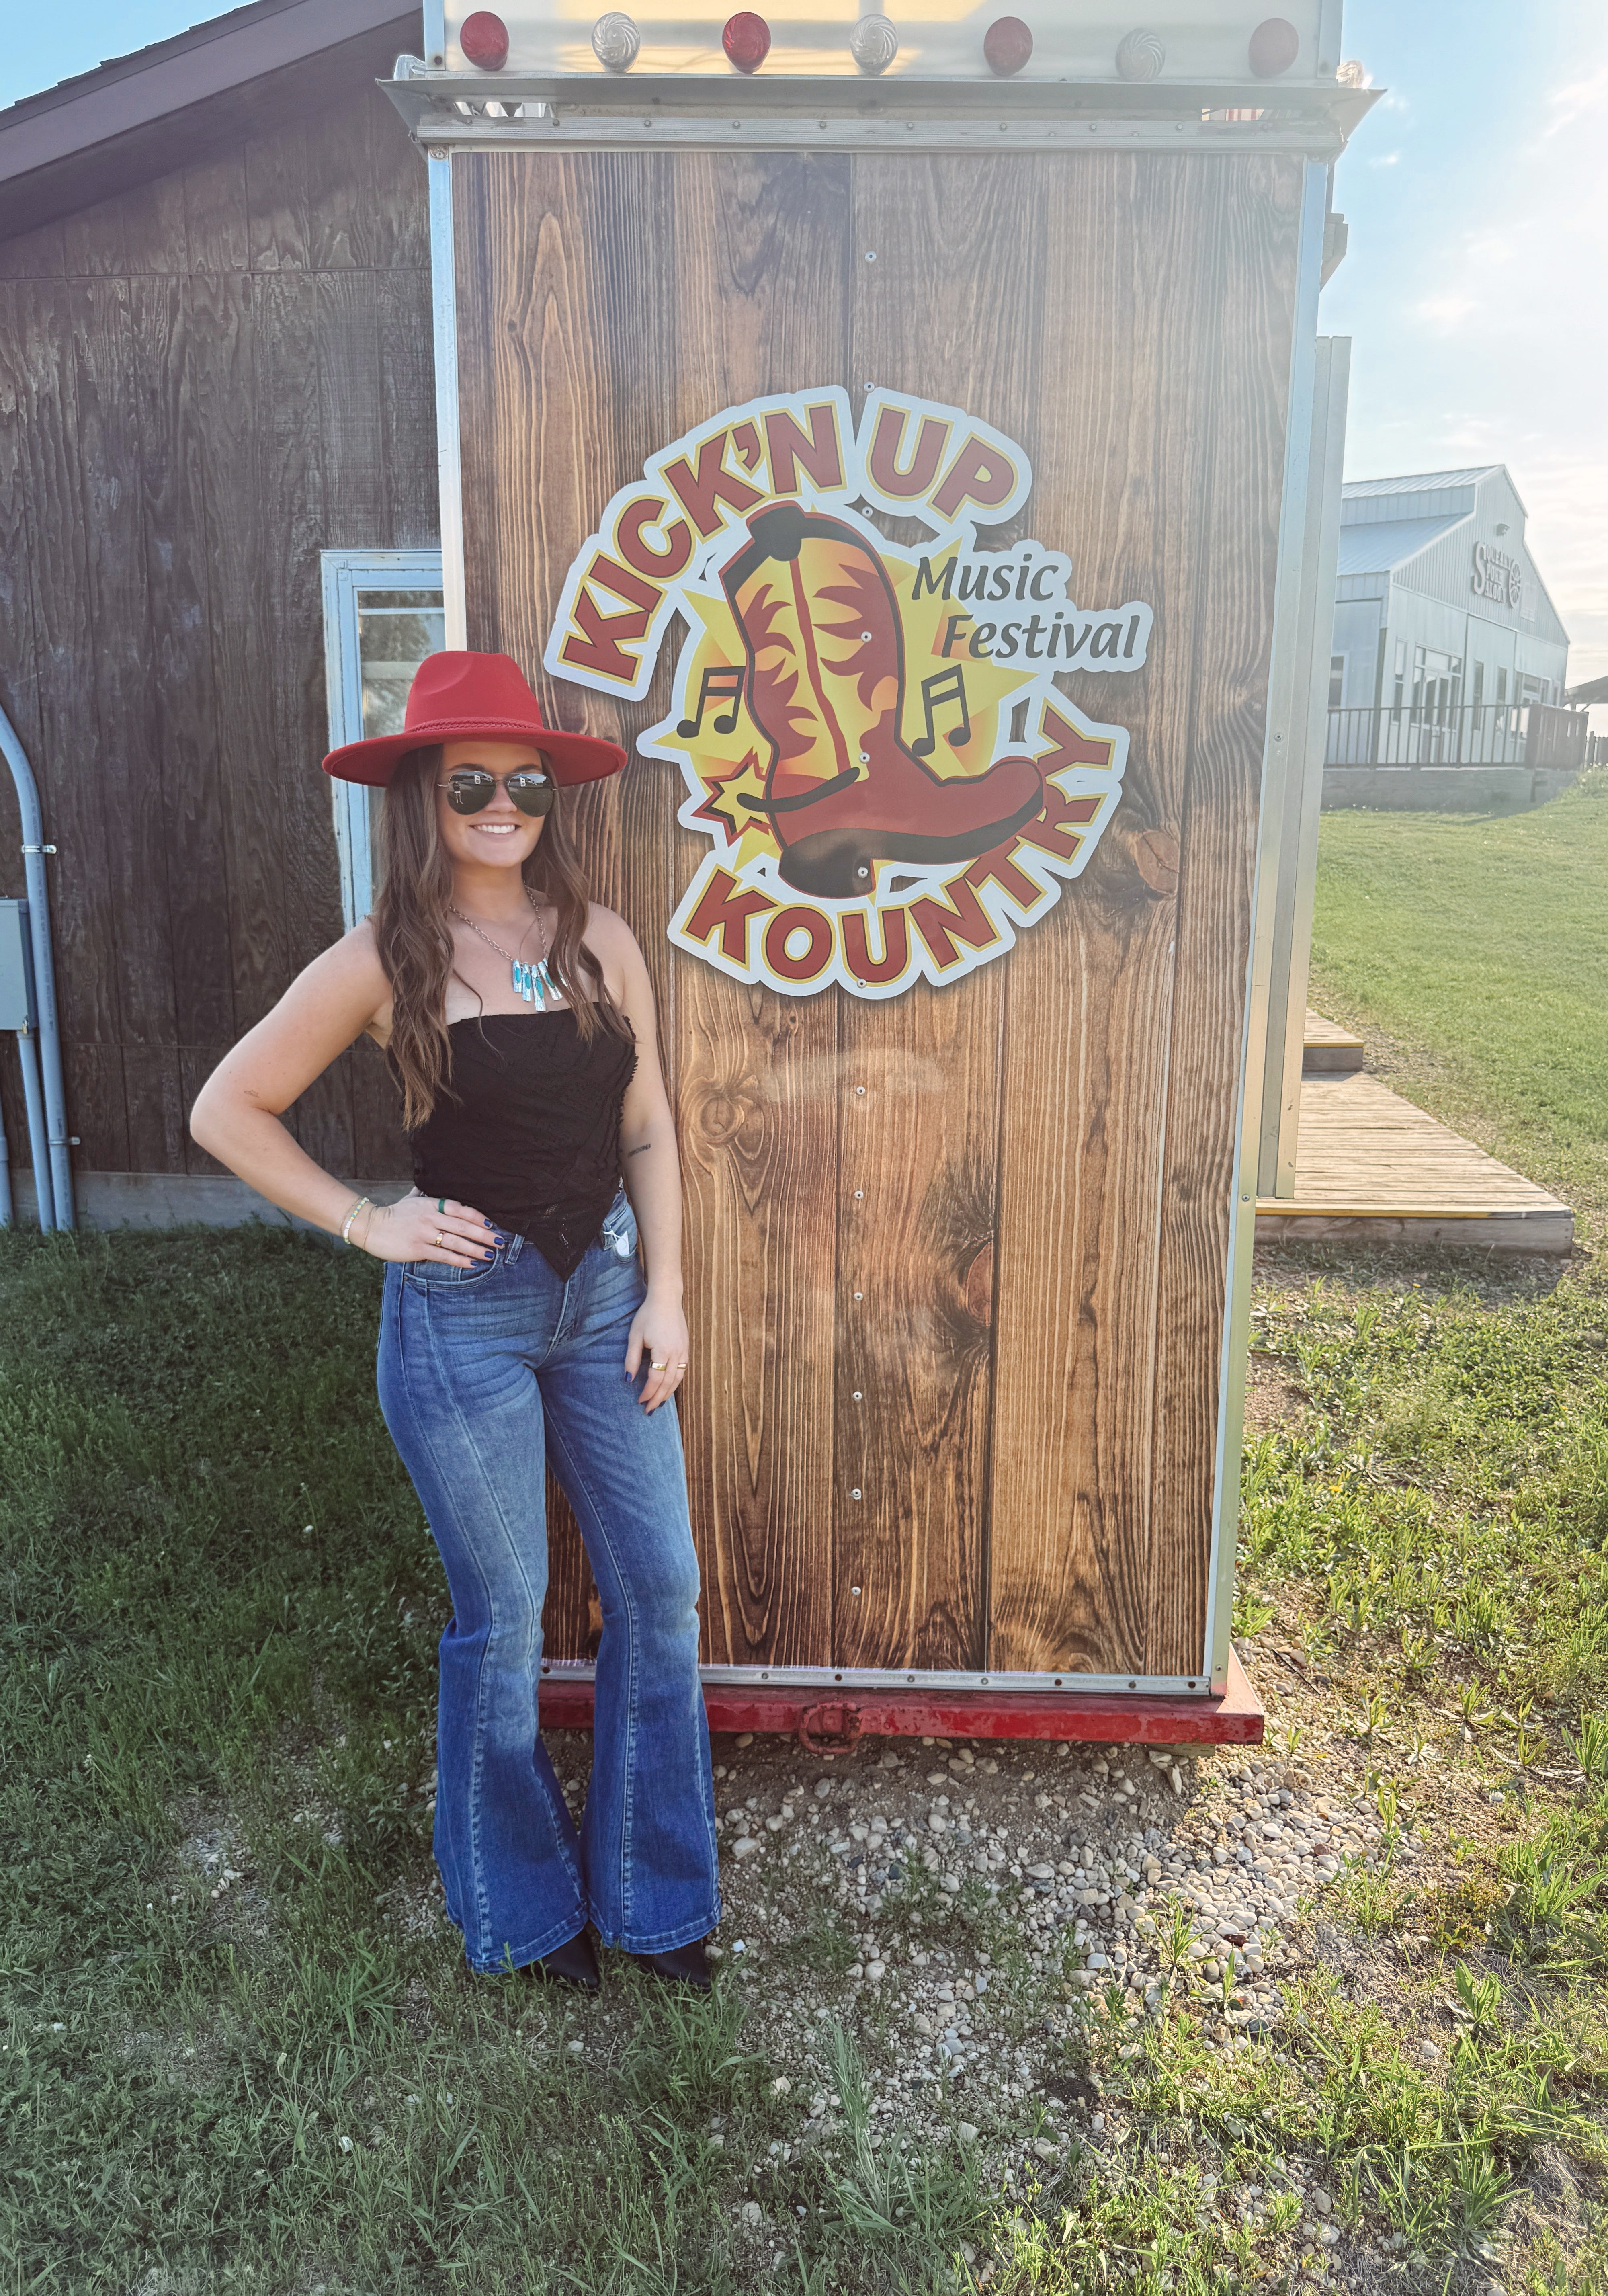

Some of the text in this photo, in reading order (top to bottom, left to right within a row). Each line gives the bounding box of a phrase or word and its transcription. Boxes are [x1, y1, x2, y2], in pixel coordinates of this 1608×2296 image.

[556, 400, 1019, 688] KICK'N UP
[912, 550, 1059, 601] Music
[942, 613, 1141, 660] Festival
[679, 697, 1117, 987] KOUNTRY
